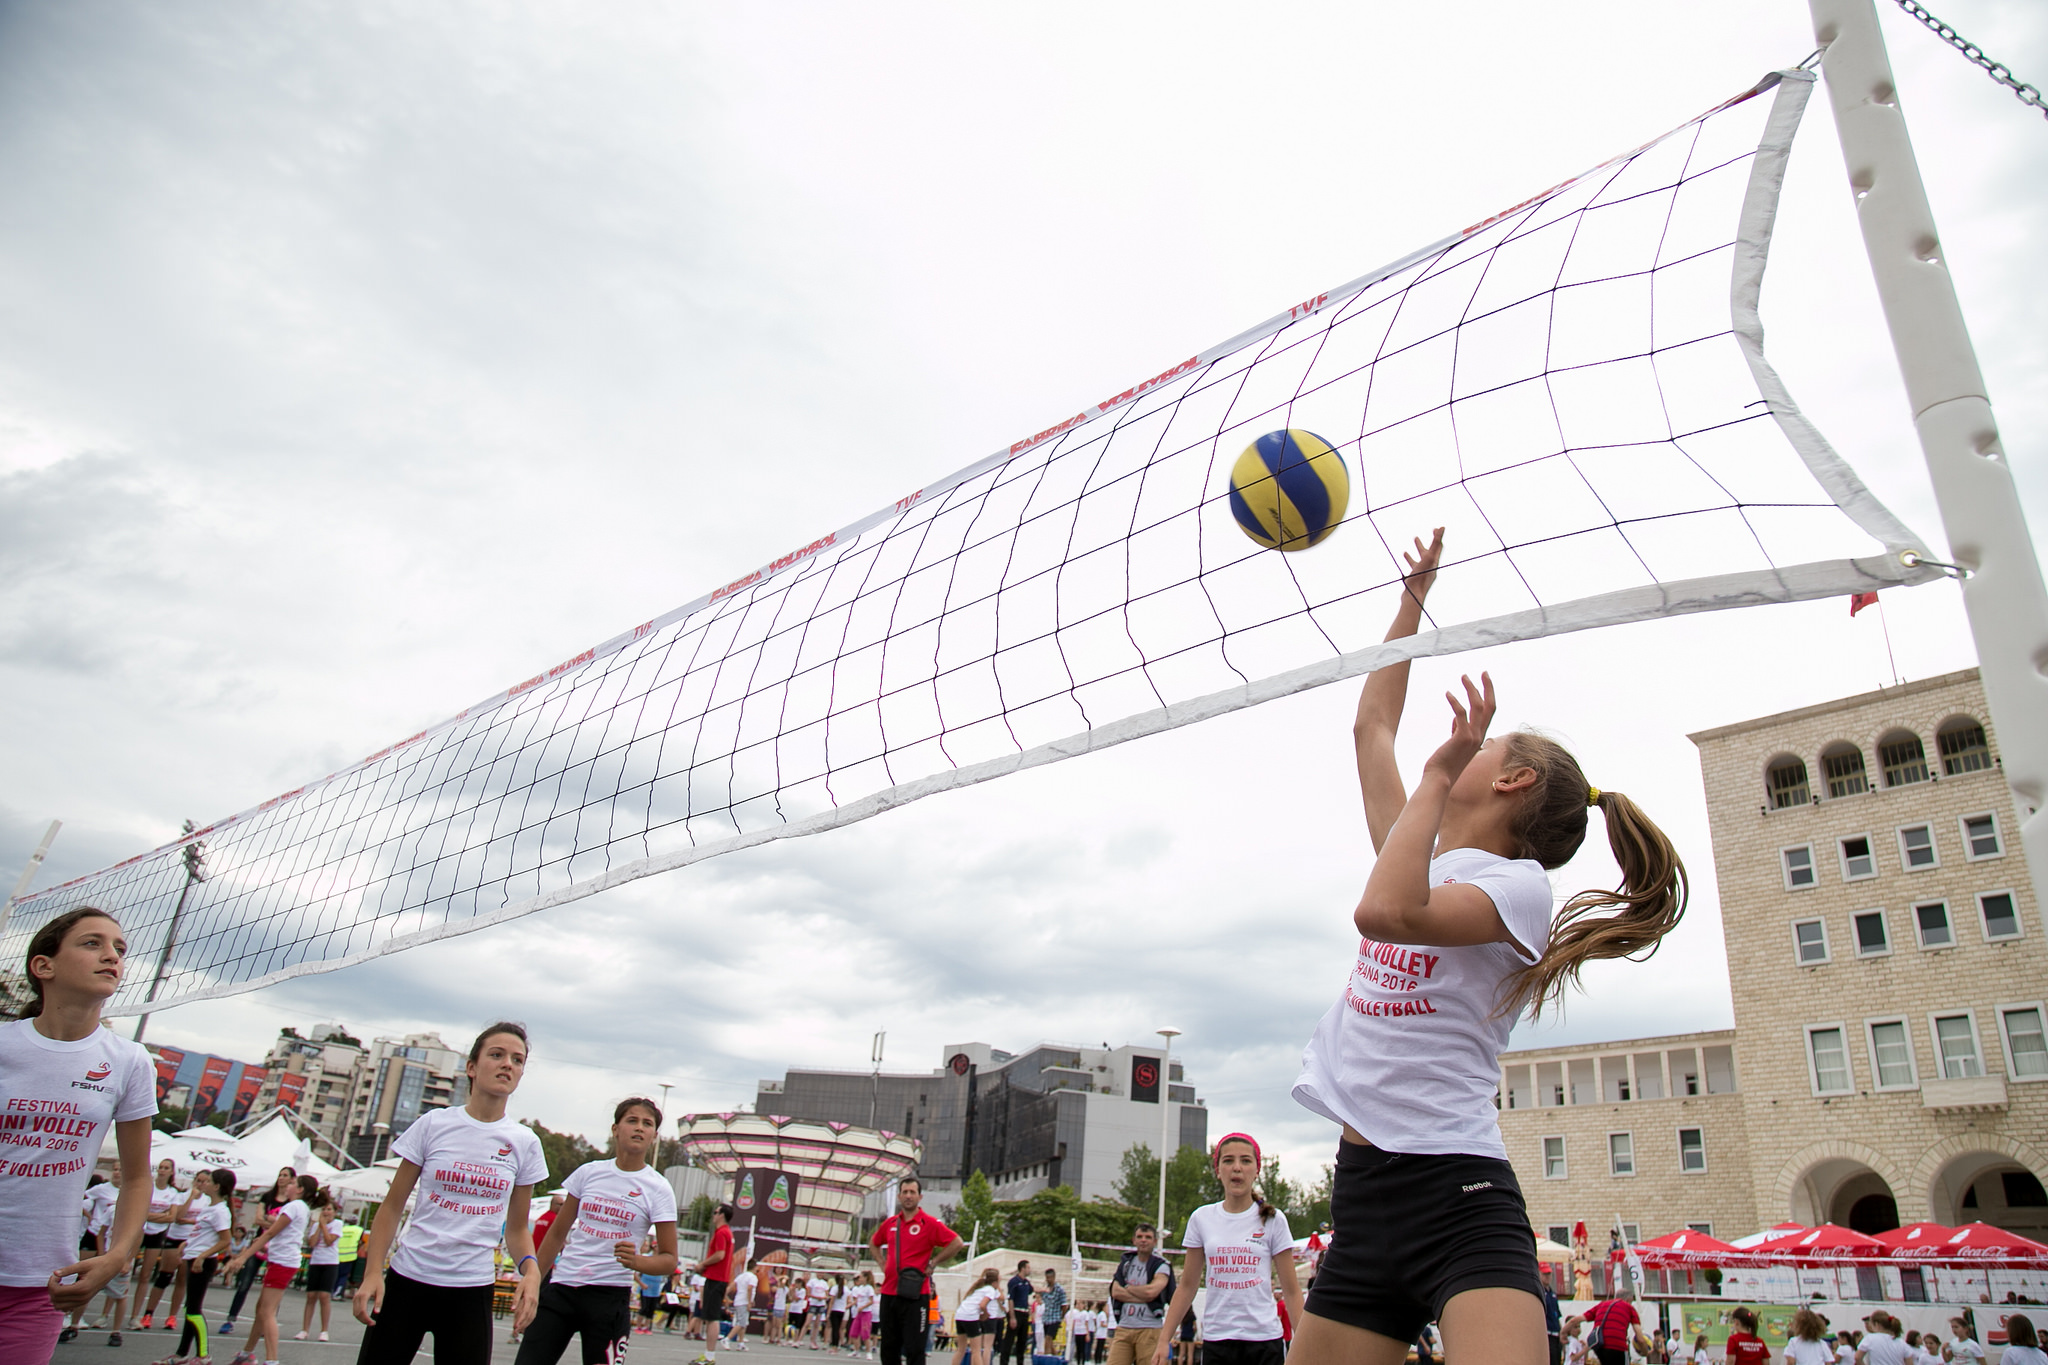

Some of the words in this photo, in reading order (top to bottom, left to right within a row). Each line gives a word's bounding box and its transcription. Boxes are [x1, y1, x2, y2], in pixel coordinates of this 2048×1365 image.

[1288, 292, 1329, 321] TVF
[895, 489, 923, 514] TVF
[633, 620, 654, 640] TVF
[1374, 941, 1440, 979] VOLLEY
[1381, 973, 1418, 992] 2016
[71, 1081, 105, 1092] FSHV
[7, 1098, 81, 1115] FESTIVAL
[32, 1116, 98, 1138] VOLLEY
[45, 1138, 79, 1152] 2016
[9, 1156, 87, 1177] VOLLEYBALL
[453, 1161, 499, 1176] FESTIVAL
[435, 1169, 466, 1184] MINI
[470, 1174, 511, 1192] VOLLEY
[1462, 1181, 1493, 1193] Reebok
[442, 1184, 478, 1196] TIRANA
[480, 1189, 502, 1200] 2016
[429, 1190, 441, 1204] WE
[439, 1198, 460, 1213] LOVE
[461, 1203, 504, 1216] VOLLEYBALL
[594, 1196, 627, 1209] FESTIVAL
[581, 1202, 601, 1214] MINI
[604, 1206, 637, 1222] VOLLEY
[586, 1213, 609, 1223] TIRANA
[611, 1218, 628, 1228] 2016
[596, 1230, 632, 1240] VOLLEYBALL
[1216, 1246, 1253, 1254] FESTIVAL
[1208, 1256, 1229, 1266] MINI
[1231, 1255, 1261, 1266] VOLLEY
[1213, 1267, 1240, 1275] TIRANA
[1629, 1266, 1638, 1280] 6
